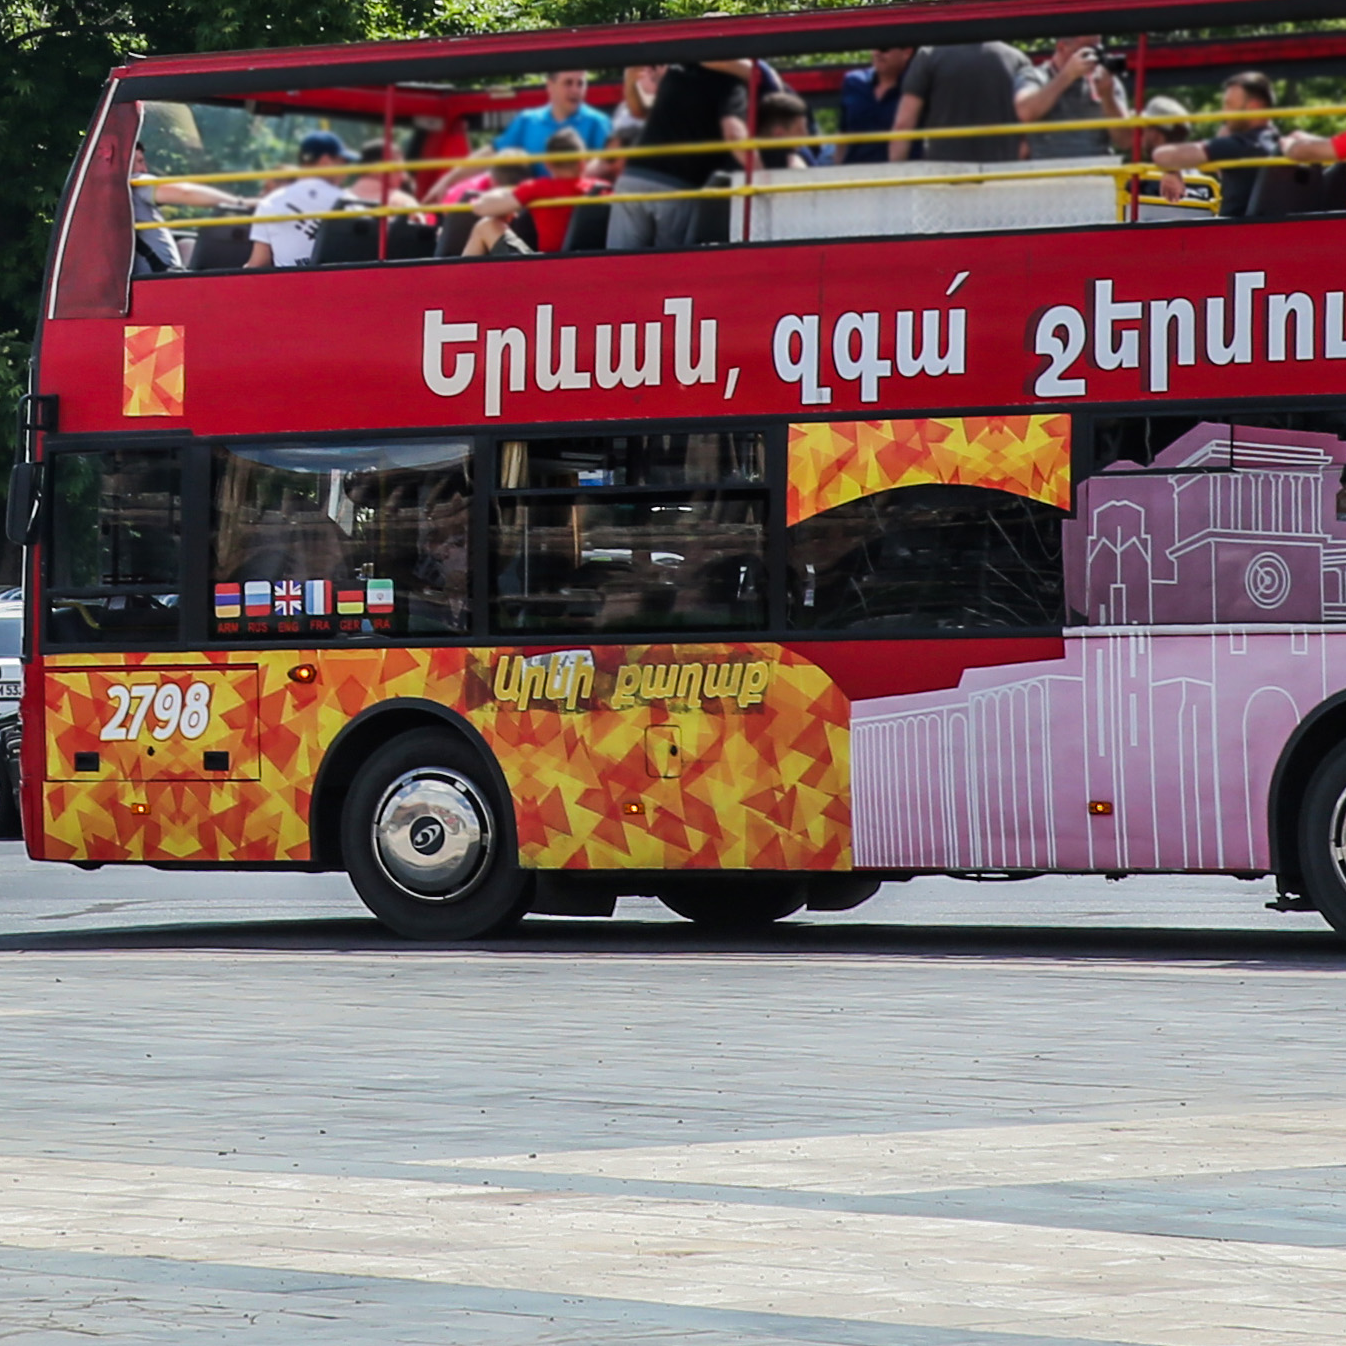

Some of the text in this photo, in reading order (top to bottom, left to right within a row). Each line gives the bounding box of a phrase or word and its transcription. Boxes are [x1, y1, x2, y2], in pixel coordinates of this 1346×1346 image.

[422, 297, 740, 417] Երևան,
[217, 622, 239, 633] ARM
[247, 621, 269, 633] RUS
[277, 621, 299, 633] ENG
[310, 619, 331, 630] FRA
[6, 685, 22, 696] 53
[100, 681, 211, 741] 2798
